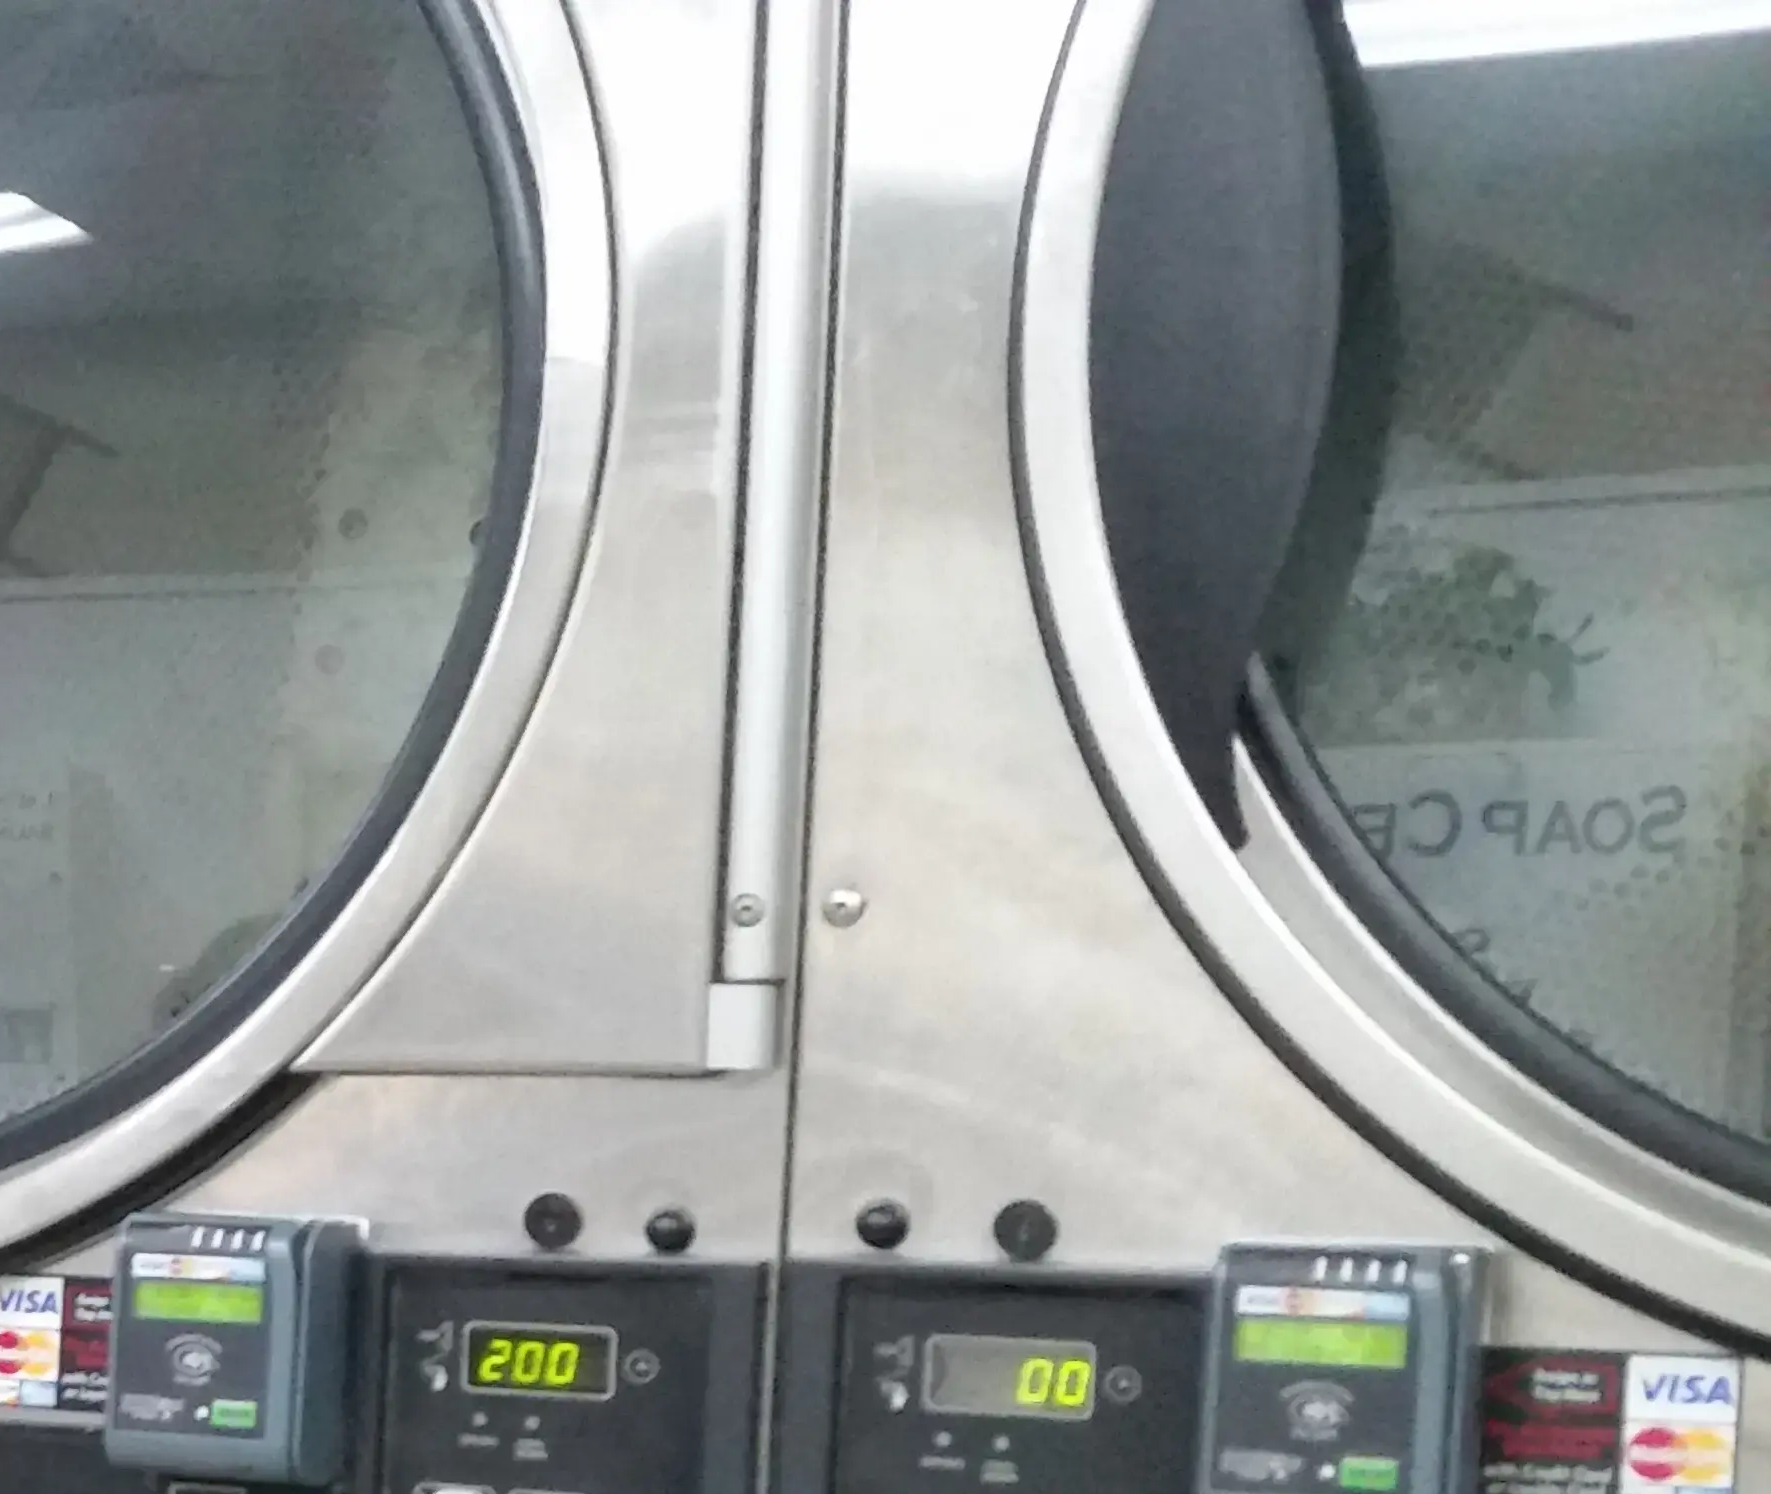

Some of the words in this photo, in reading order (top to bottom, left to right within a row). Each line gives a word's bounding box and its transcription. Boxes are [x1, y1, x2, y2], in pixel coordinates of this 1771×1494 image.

[0, 1288, 59, 1314] VISA
[477, 1338, 581, 1385] 200
[1016, 1357, 1092, 1406] 00
[1642, 1372, 1735, 1405] VISA
